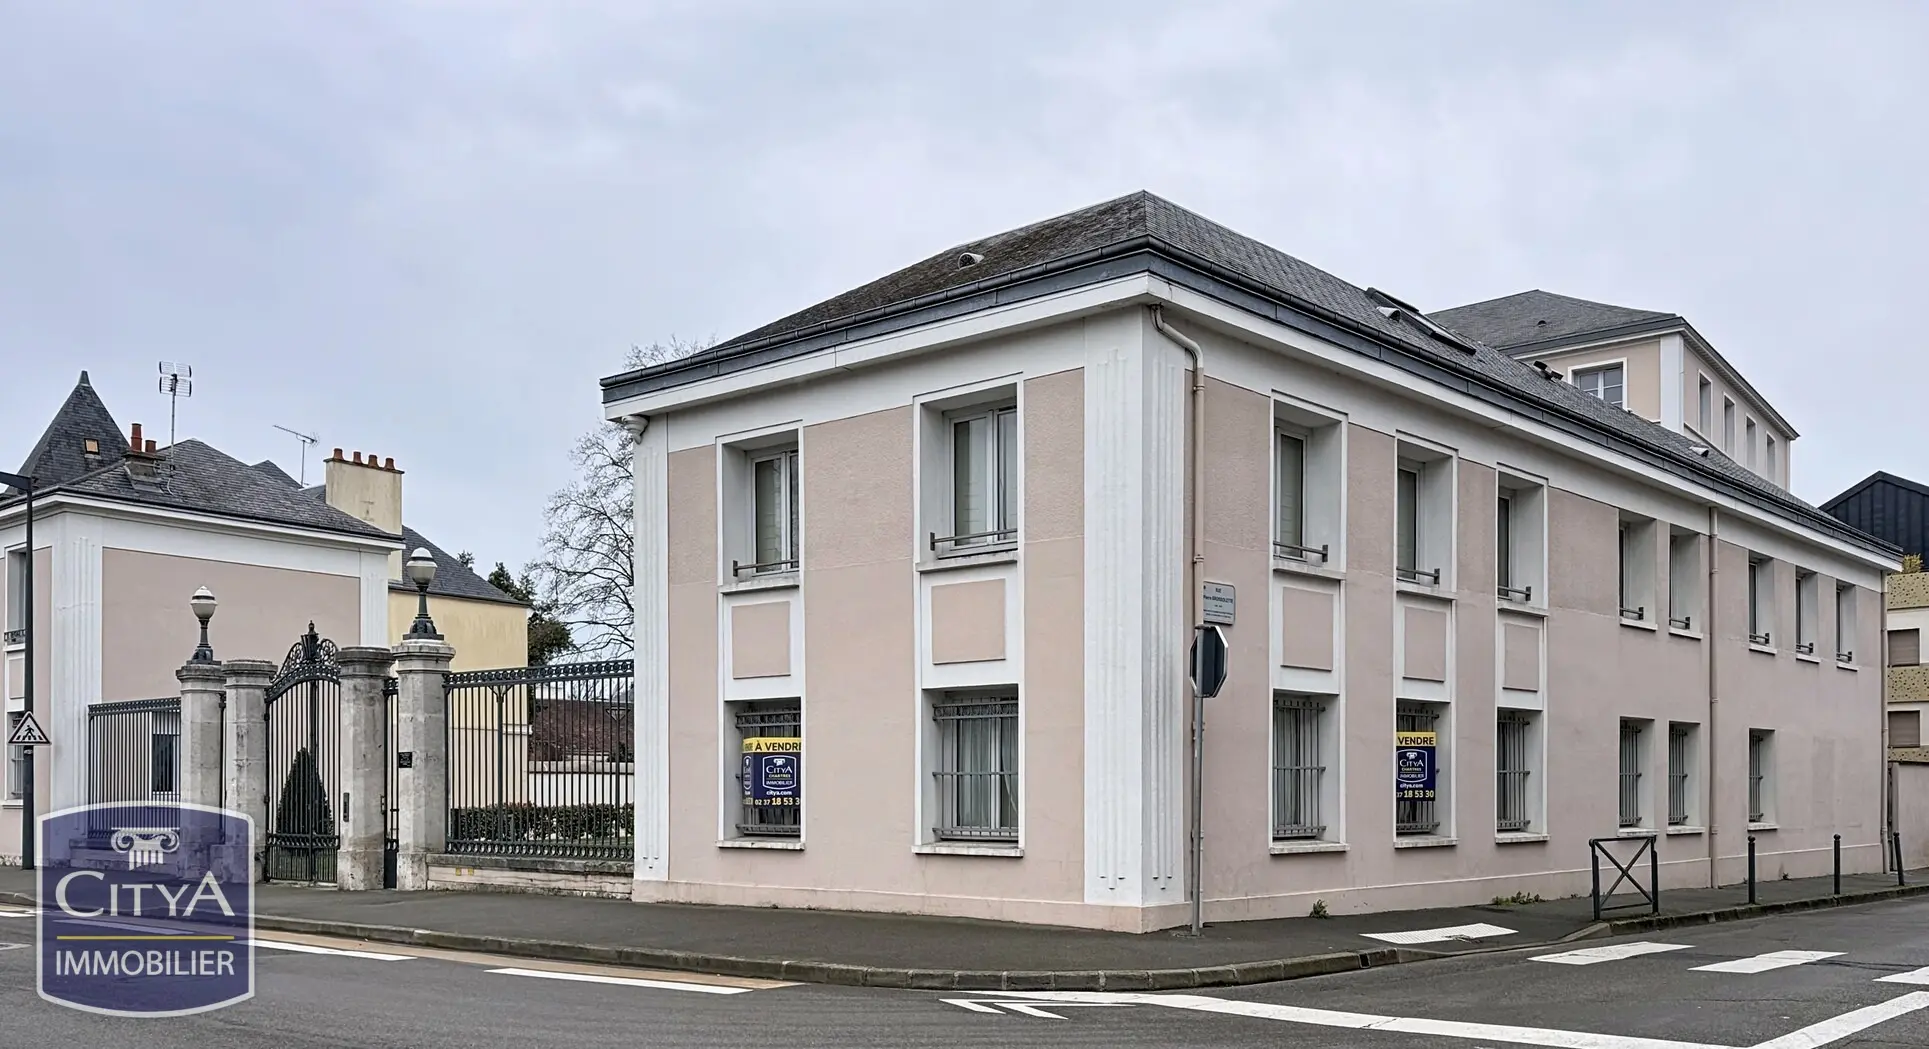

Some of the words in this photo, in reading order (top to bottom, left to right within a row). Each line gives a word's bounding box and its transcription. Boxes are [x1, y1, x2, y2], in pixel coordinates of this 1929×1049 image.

[1397, 736, 1434, 745] VENDRE
[755, 740, 762, 751] À
[765, 742, 801, 751] VENDR
[1404, 790, 1413, 798] 18
[1415, 790, 1423, 798] 53
[1425, 790, 1434, 798] 30
[772, 797, 781, 805] 18
[784, 797, 793, 805] 53
[795, 797, 800, 805] 3
